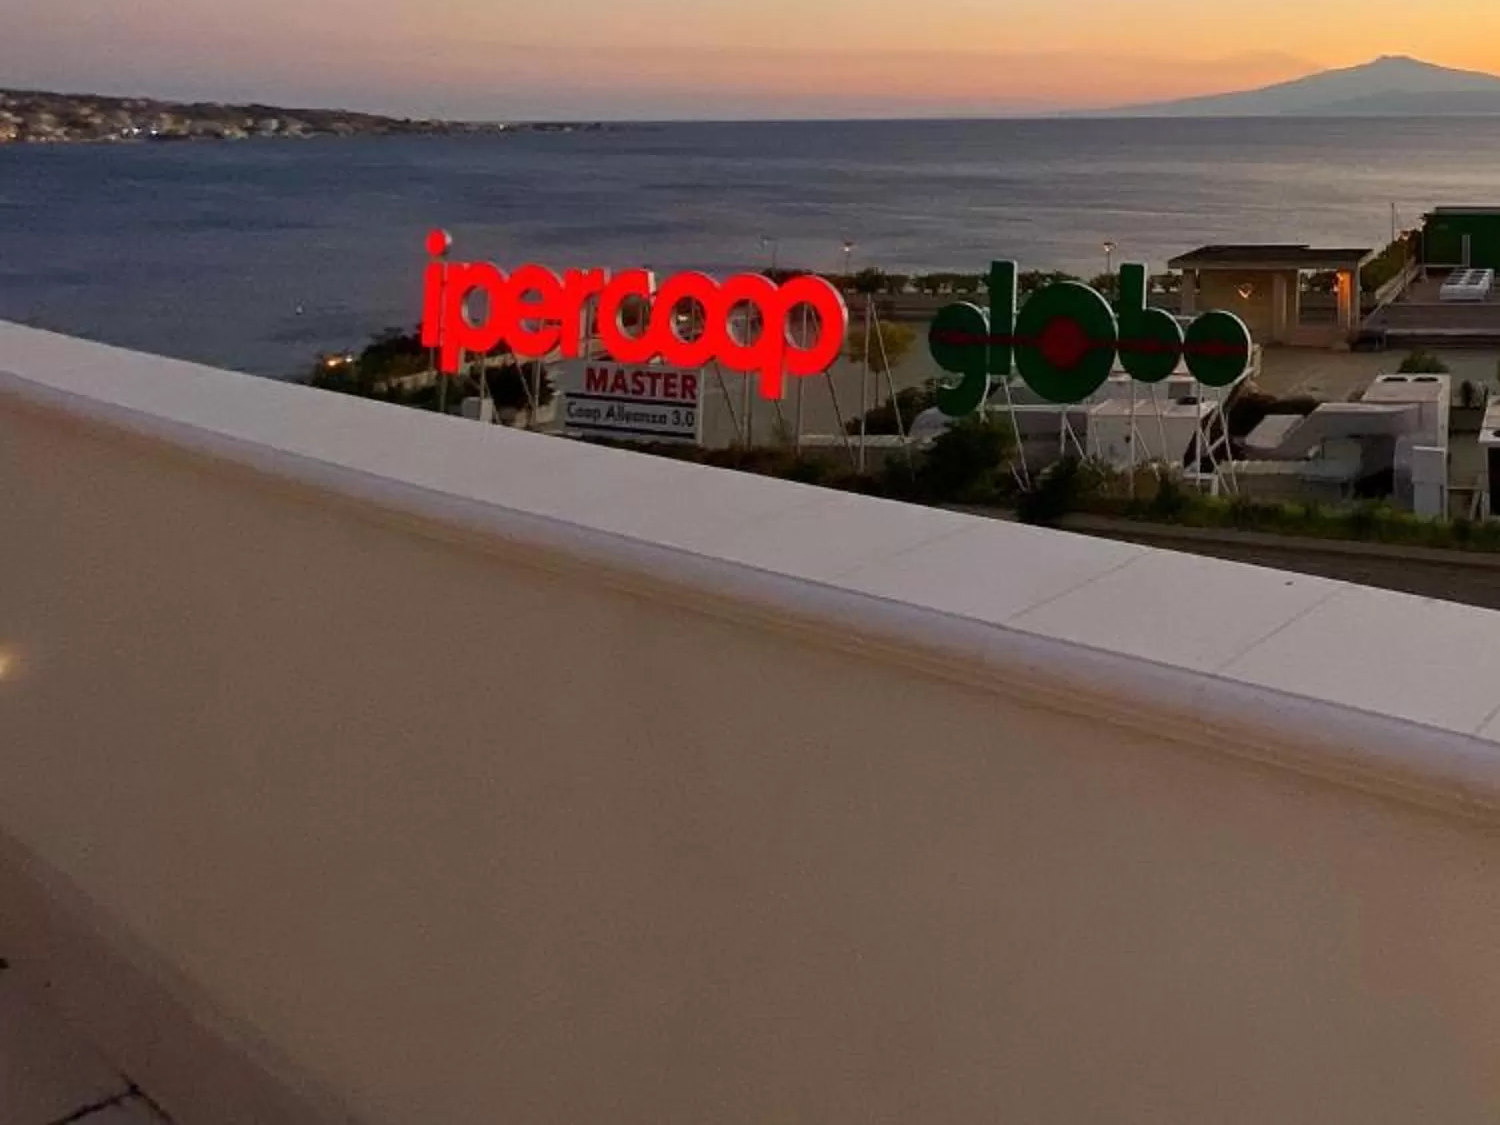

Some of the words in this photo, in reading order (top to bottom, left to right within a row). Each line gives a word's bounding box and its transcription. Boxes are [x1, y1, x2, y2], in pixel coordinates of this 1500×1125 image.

[421, 229, 848, 400] ipercoop
[929, 260, 1252, 416] globo
[585, 367, 697, 399] MASTER
[672, 410, 695, 427] 3.0
